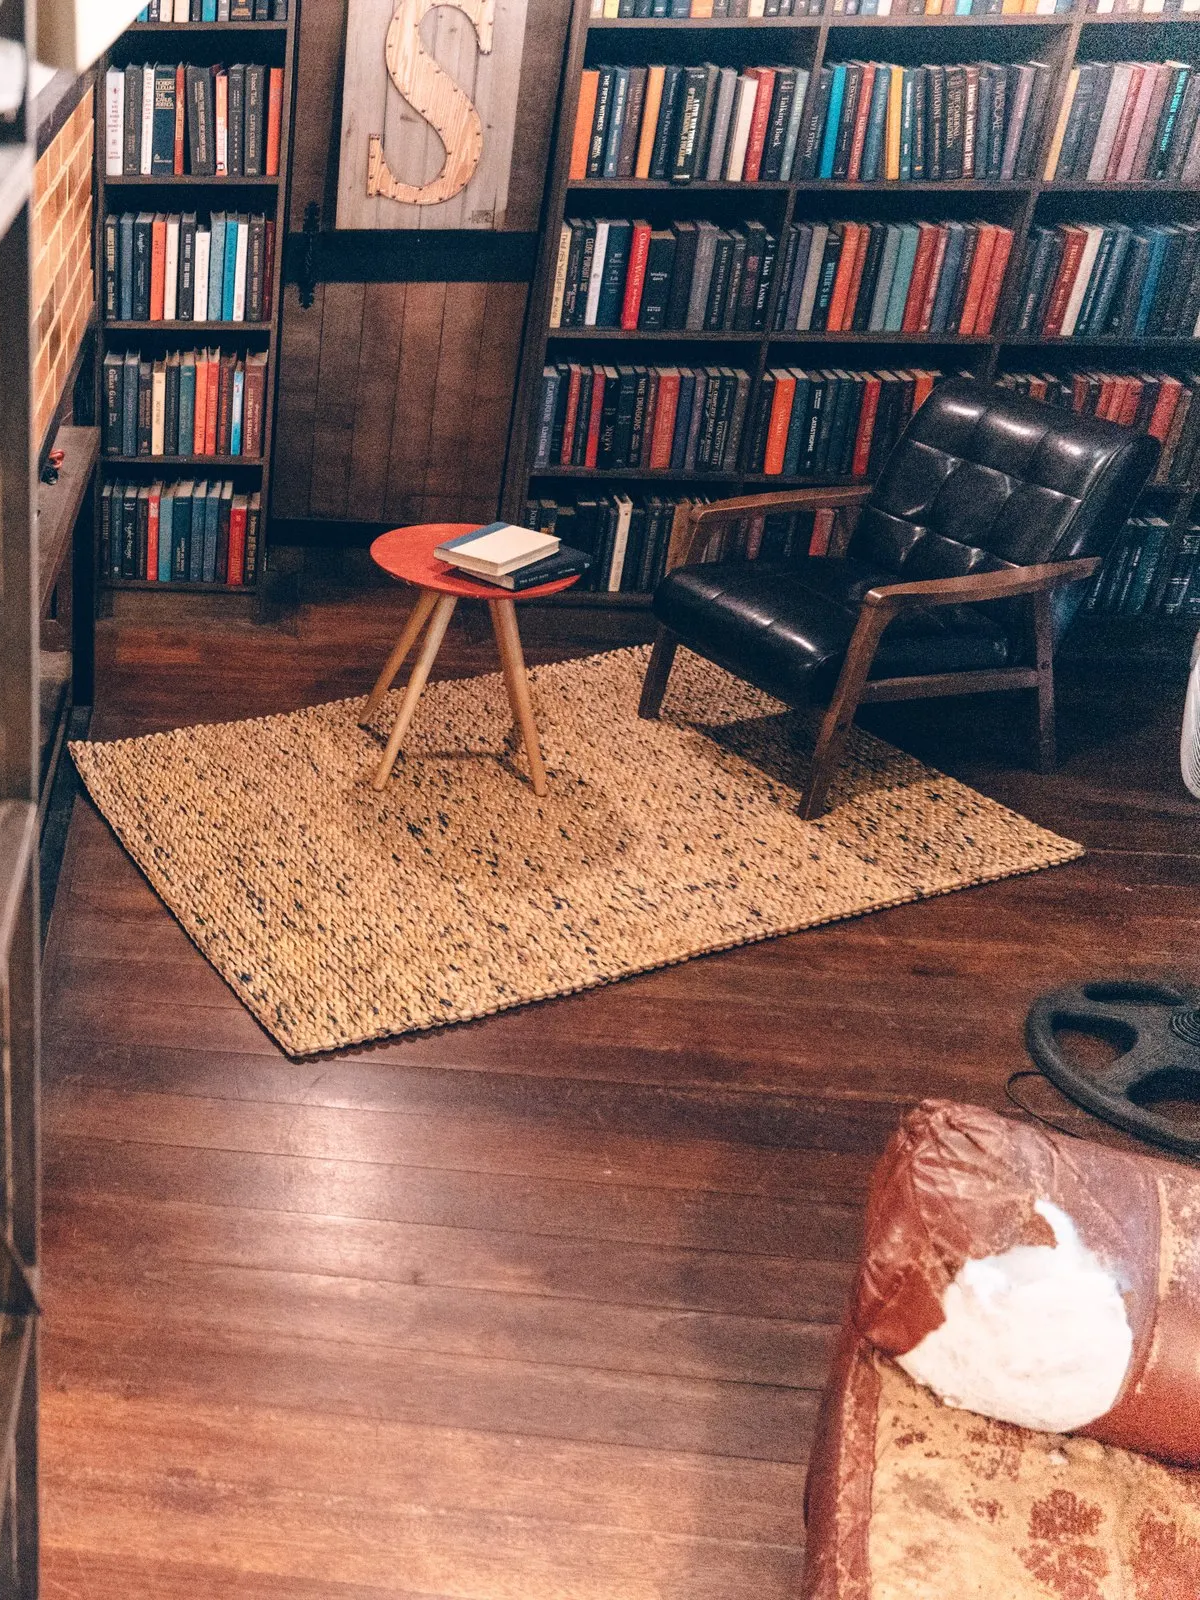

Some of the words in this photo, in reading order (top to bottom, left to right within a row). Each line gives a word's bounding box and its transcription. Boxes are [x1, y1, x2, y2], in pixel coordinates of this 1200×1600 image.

[368, 0, 495, 206] S
[600, 87, 608, 104] FIFTH
[933, 74, 941, 119] FLASHPOINT
[595, 105, 605, 131] WITNESS
[774, 95, 789, 127] Talking
[772, 127, 783, 148] Back
[804, 131, 815, 158] ANGELS
[964, 113, 974, 152] American
[136, 231, 144, 254] Angler
[583, 237, 594, 255] CLOSE
[580, 255, 591, 278] PURSUIT
[632, 264, 642, 286] WARS
[762, 255, 773, 276] TEAM
[712, 293, 720, 315] BEAUTY
[756, 280, 769, 310] YANKEE
[108, 390, 116, 408] GAME
[637, 378, 645, 396] NINE
[633, 397, 643, 430] DRAGONS
[713, 419, 724, 450] AGENDA
[806, 415, 817, 453] CATASTROPHE
